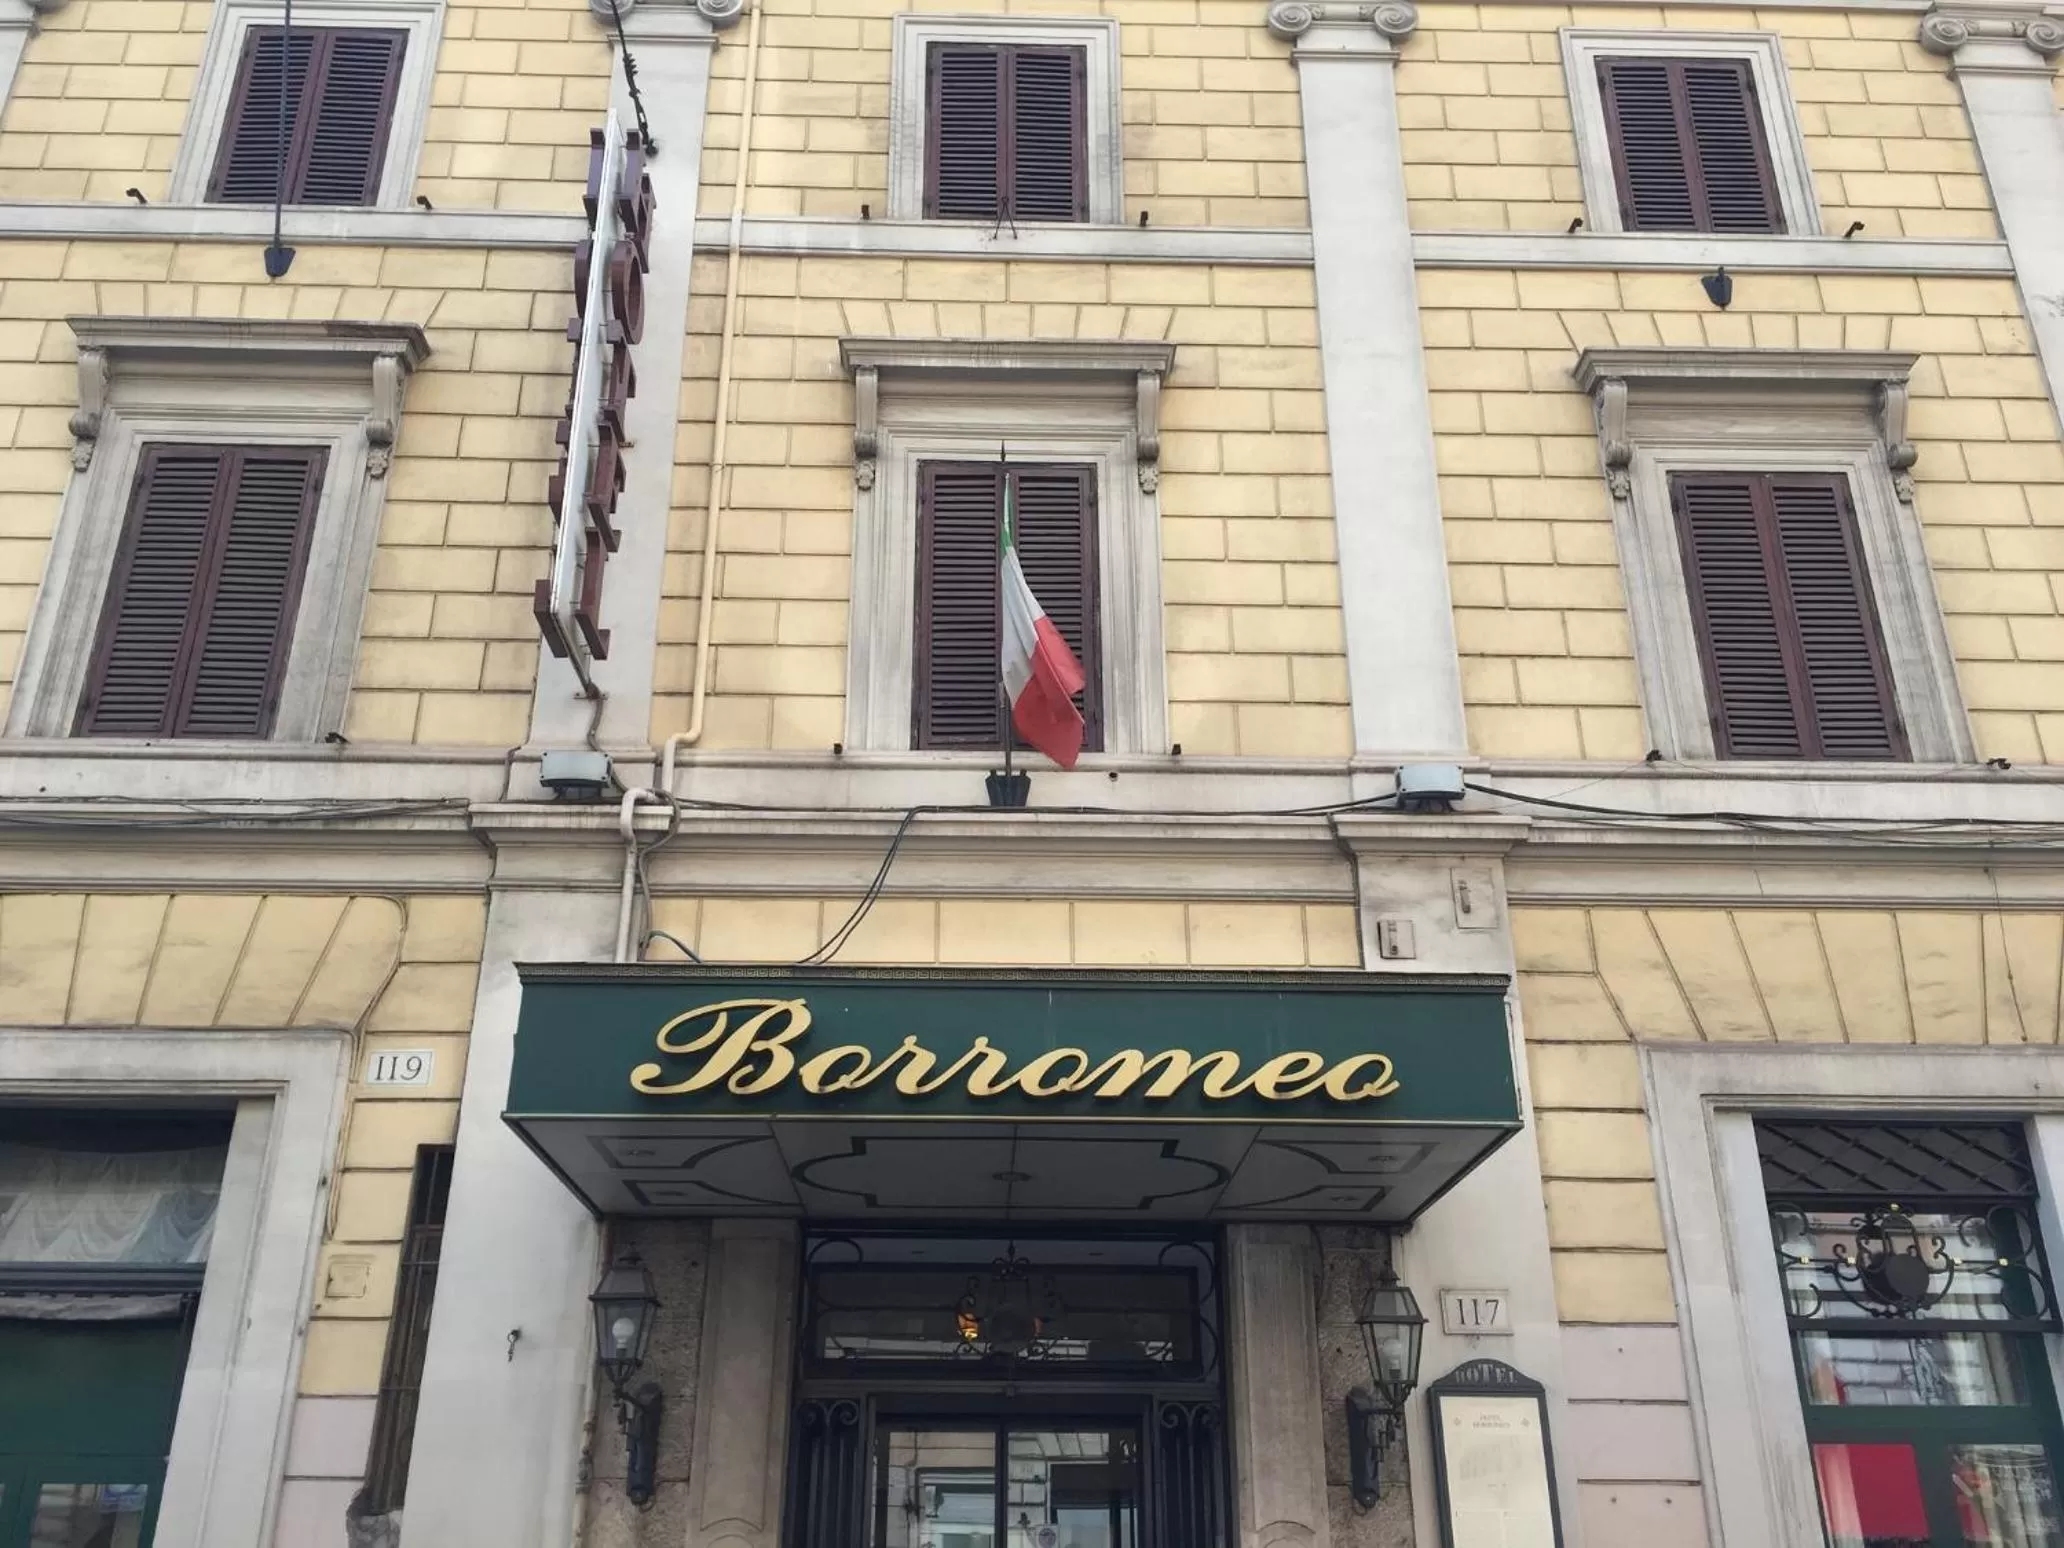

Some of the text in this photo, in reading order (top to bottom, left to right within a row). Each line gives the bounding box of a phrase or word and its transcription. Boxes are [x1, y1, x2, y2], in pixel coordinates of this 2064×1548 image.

[631, 998, 1399, 1100] Borromeo
[374, 1055, 422, 1081] 119
[1456, 1298, 1499, 1325] 117
[1455, 1363, 1518, 1384] HOTEL
